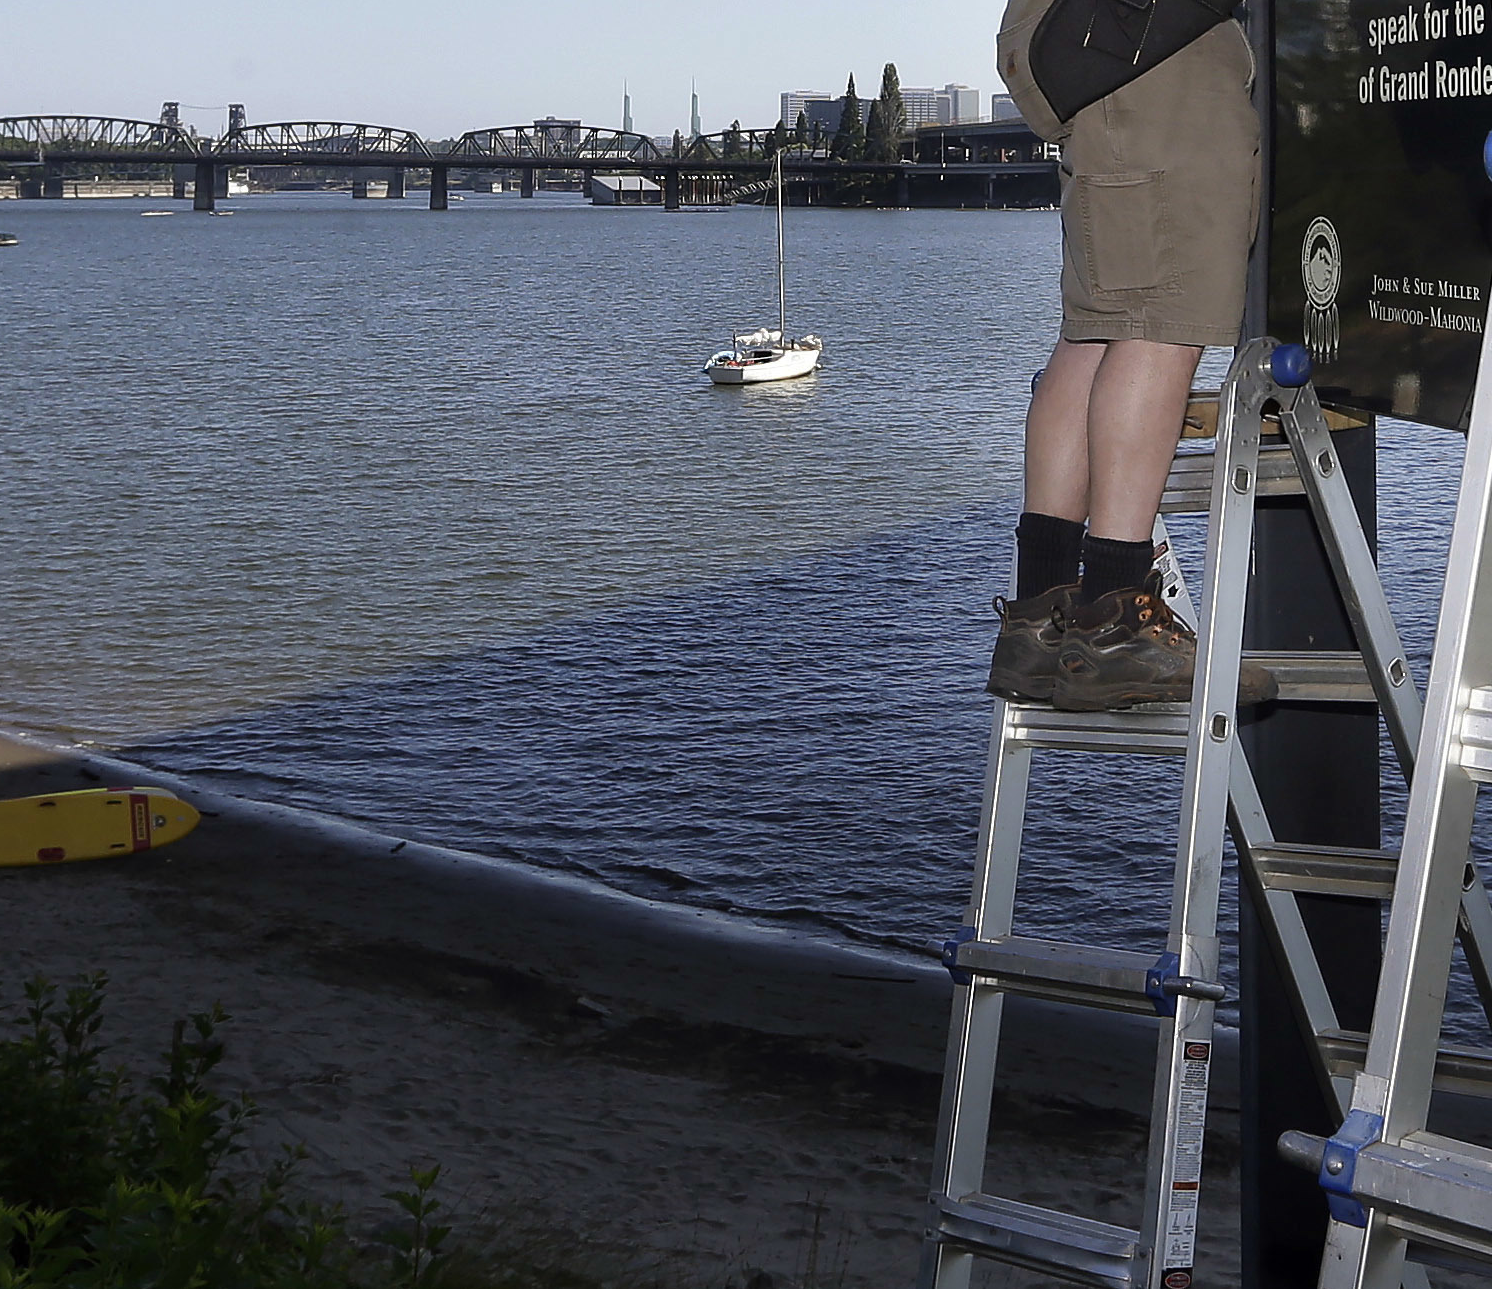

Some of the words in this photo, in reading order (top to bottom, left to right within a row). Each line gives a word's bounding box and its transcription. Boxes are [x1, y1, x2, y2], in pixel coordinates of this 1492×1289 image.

[1368, 5, 1419, 55] speak
[1423, 1, 1449, 40] for
[1359, 66, 1375, 104] of
[1379, 61, 1429, 103] Grand
[1402, 276, 1411, 295] &
